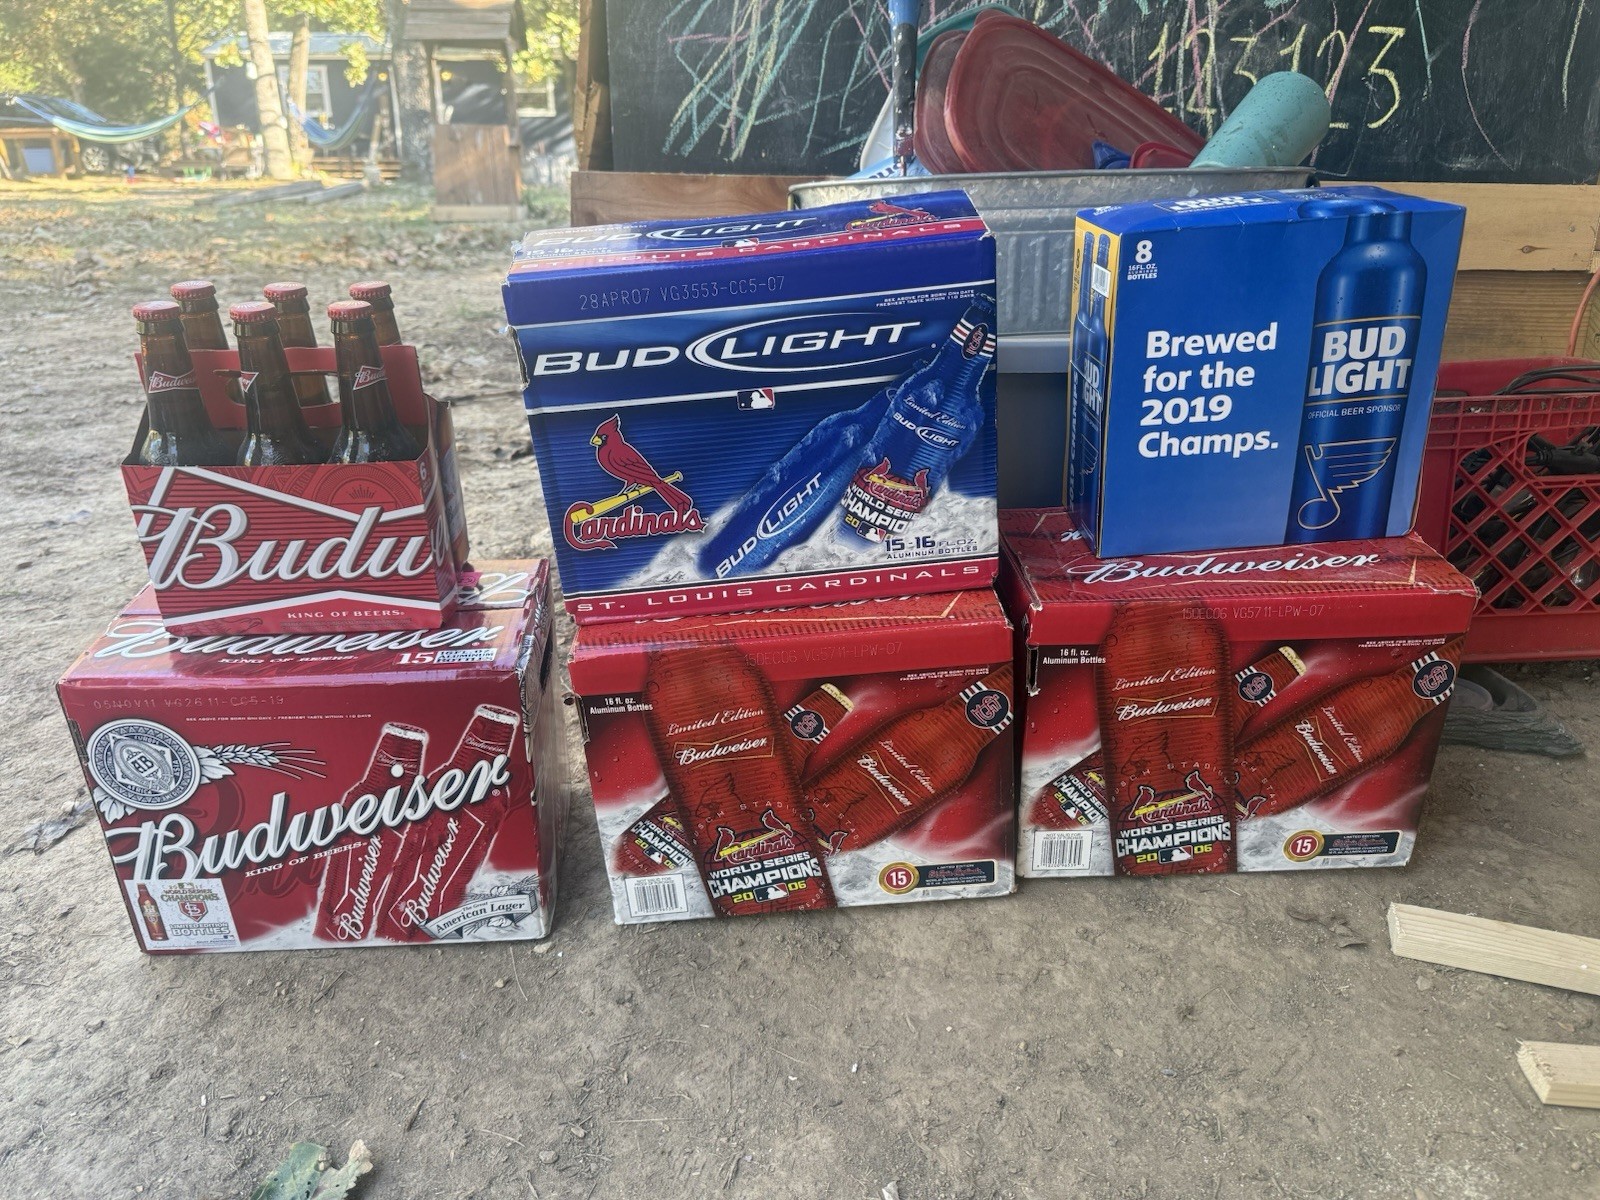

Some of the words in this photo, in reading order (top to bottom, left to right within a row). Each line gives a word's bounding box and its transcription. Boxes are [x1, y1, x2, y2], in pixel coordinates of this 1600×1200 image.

[669, 217, 818, 238] LIGHT
[1135, 240, 1153, 264] 8
[1127, 273, 1158, 281] BOTTLES
[579, 288, 651, 311] 28APR07
[533, 345, 680, 377] BUD
[720, 321, 922, 360] LIGHT
[1145, 322, 1279, 359] Brewed
[1321, 325, 1407, 364] BUD
[1143, 365, 1193, 393] for
[1200, 361, 1256, 388] the
[1308, 358, 1413, 398] LIGHT
[1139, 394, 1234, 426] 2019
[1308, 409, 1340, 420] OFFICIAL
[1341, 406, 1365, 417] BEER
[1366, 404, 1401, 414] SPONSOR
[892, 411, 918, 432] BUD
[922, 427, 960, 447] LIGHT
[1137, 428, 1280, 459] Champs.
[851, 482, 886, 511] WORLD
[563, 501, 709, 551] Cardinals
[715, 536, 758, 579] BUD
[766, 472, 822, 533] LIGHT
[886, 550, 935, 560] ALUMINUM
[938, 545, 978, 555] BOTTLES
[1067, 552, 1381, 585] Budweiser
[577, 601, 626, 612] ST.
[647, 588, 755, 606] LOUIS
[775, 566, 981, 594] CARDINALS
[396, 652, 434, 665] 15
[1042, 656, 1079, 665] Aluminum
[1080, 656, 1107, 664] Bottles
[1060, 648, 1069, 657] 16
[1112, 669, 1171, 692] Limited
[1170, 666, 1217, 682] Edition
[590, 704, 626, 715] Aluminum
[627, 701, 653, 712] Bottles
[604, 697, 614, 706] 16
[1115, 696, 1212, 721] Budweiser
[666, 714, 718, 737] Limited
[721, 706, 765, 724] Edition
[675, 737, 768, 766] Budweiser
[1295, 719, 1338, 775] Budweiser
[857, 754, 912, 807] Budweiser
[105, 754, 512, 881] Budweiser
[1120, 822, 1174, 838] WORLD
[1175, 814, 1224, 830] SERIES
[631, 820, 694, 869] CHAMPION
[1115, 821, 1232, 858] CHAMPIONS
[1193, 843, 1213, 854] 06
[1295, 838, 1313, 854] 15
[245, 865, 279, 878] KING
[313, 841, 366, 859] BEERS
[710, 863, 762, 880] WORLD
[764, 851, 811, 868] SERIES
[1136, 852, 1158, 864] 20
[337, 833, 384, 941] Budweiser
[707, 857, 823, 899] CHAMPIONS
[787, 881, 807, 892] 06
[890, 871, 908, 887] 15
[732, 891, 754, 904] 20
[171, 926, 230, 936] BOTTLES
[436, 908, 487, 934] American
[490, 900, 526, 915] Lager
